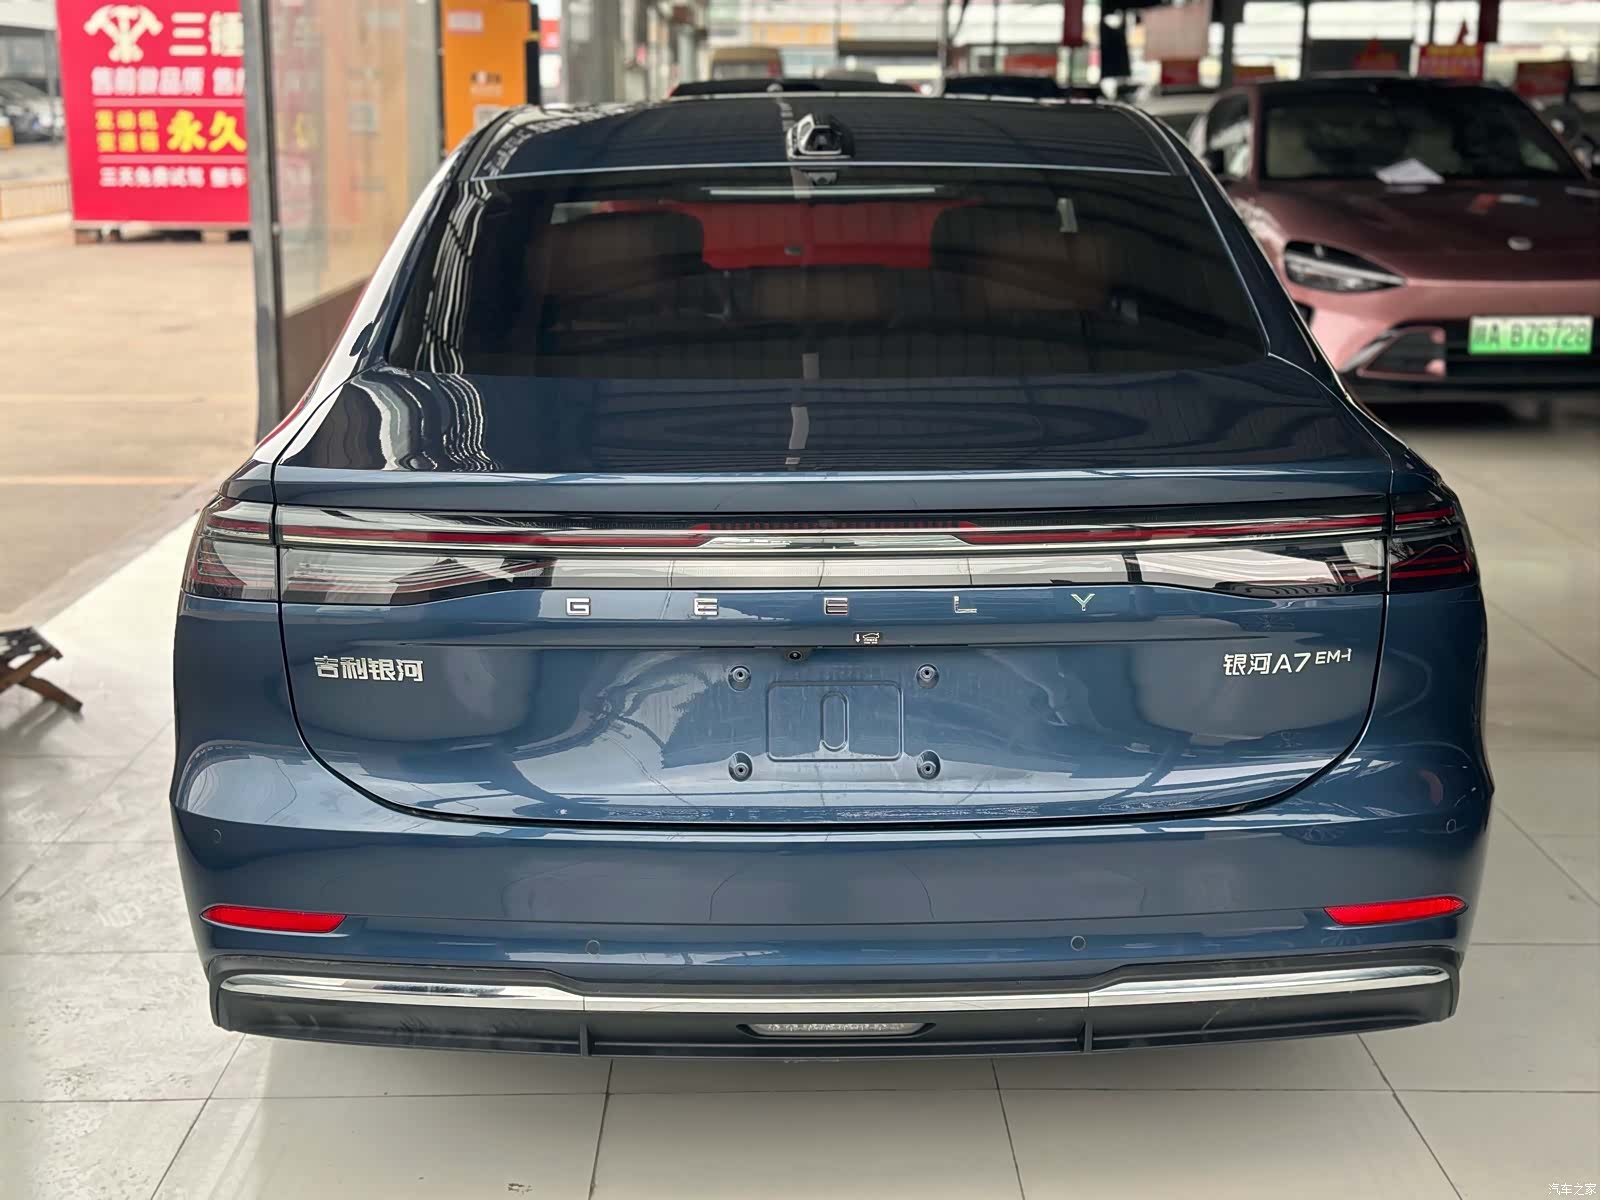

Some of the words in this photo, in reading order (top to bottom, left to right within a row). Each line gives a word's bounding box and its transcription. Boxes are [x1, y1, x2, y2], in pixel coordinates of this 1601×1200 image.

[166, 109, 247, 152] 永久
[565, 593, 1096, 616] GEELY
[313, 655, 424, 682] 吉利银河
[1223, 652, 1311, 676] 银河A7
